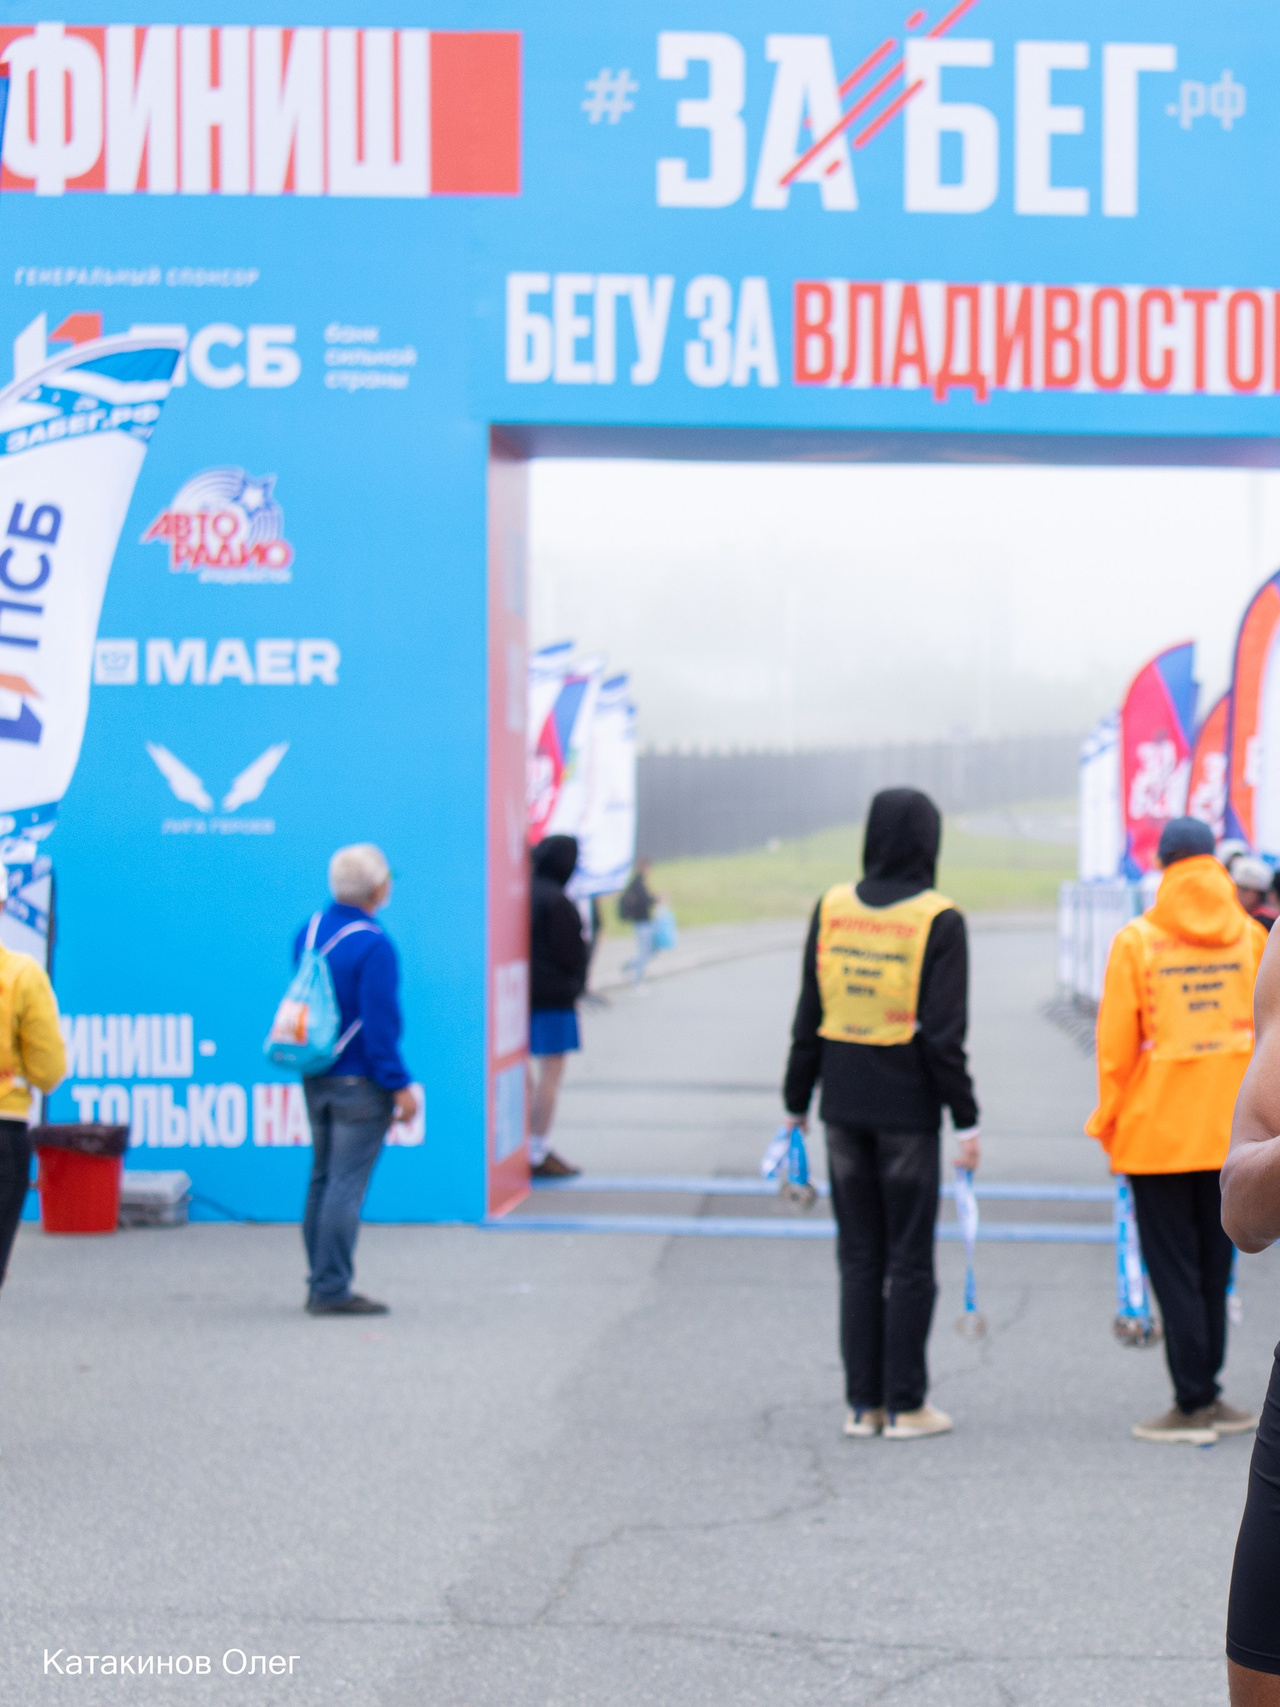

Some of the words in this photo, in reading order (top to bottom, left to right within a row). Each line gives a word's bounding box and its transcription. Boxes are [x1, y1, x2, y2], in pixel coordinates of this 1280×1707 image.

[2, 22, 430, 196] ФИНИШ
[506, 271, 675, 385] БЕГУ
[684, 274, 780, 387] ЗА
[146, 638, 340, 686] MAER
[59, 1013, 194, 1079] ИНИШ
[71, 1082, 248, 1149] ТОЛЬКО
